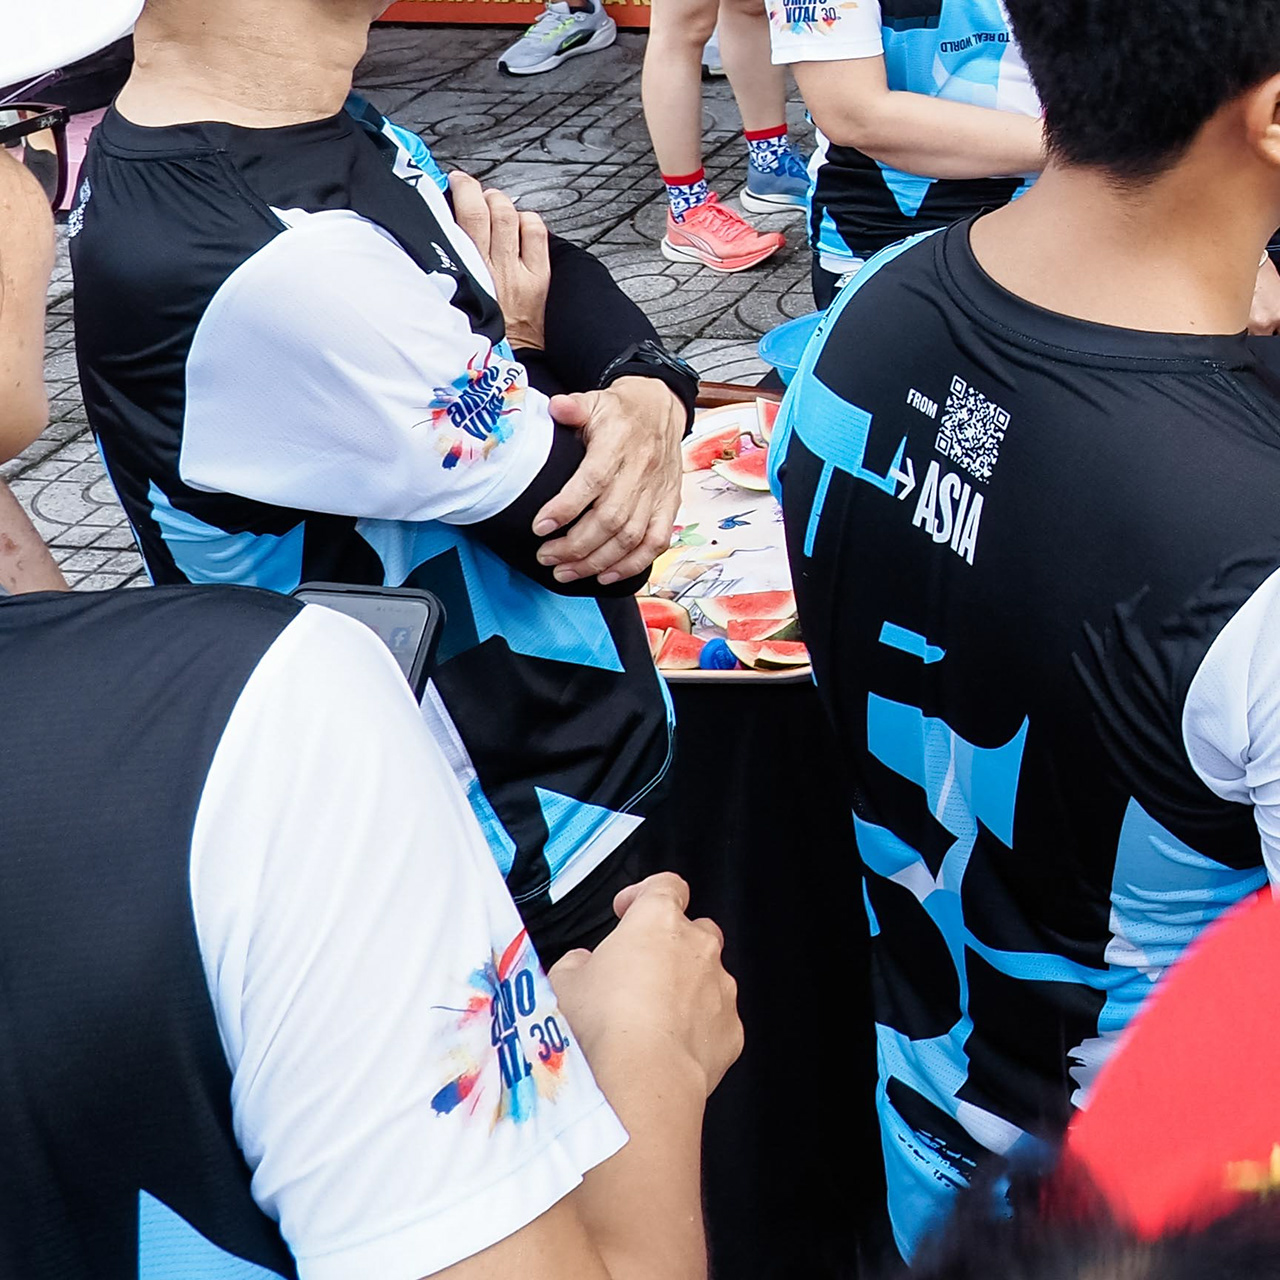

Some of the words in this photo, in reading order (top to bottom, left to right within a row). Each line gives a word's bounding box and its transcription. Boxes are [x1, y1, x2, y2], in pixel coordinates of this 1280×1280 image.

[785, 5, 818, 23] VITAL
[821, 7, 837, 21] 30
[906, 388, 938, 419] FROM
[912, 459, 984, 566] ASIA
